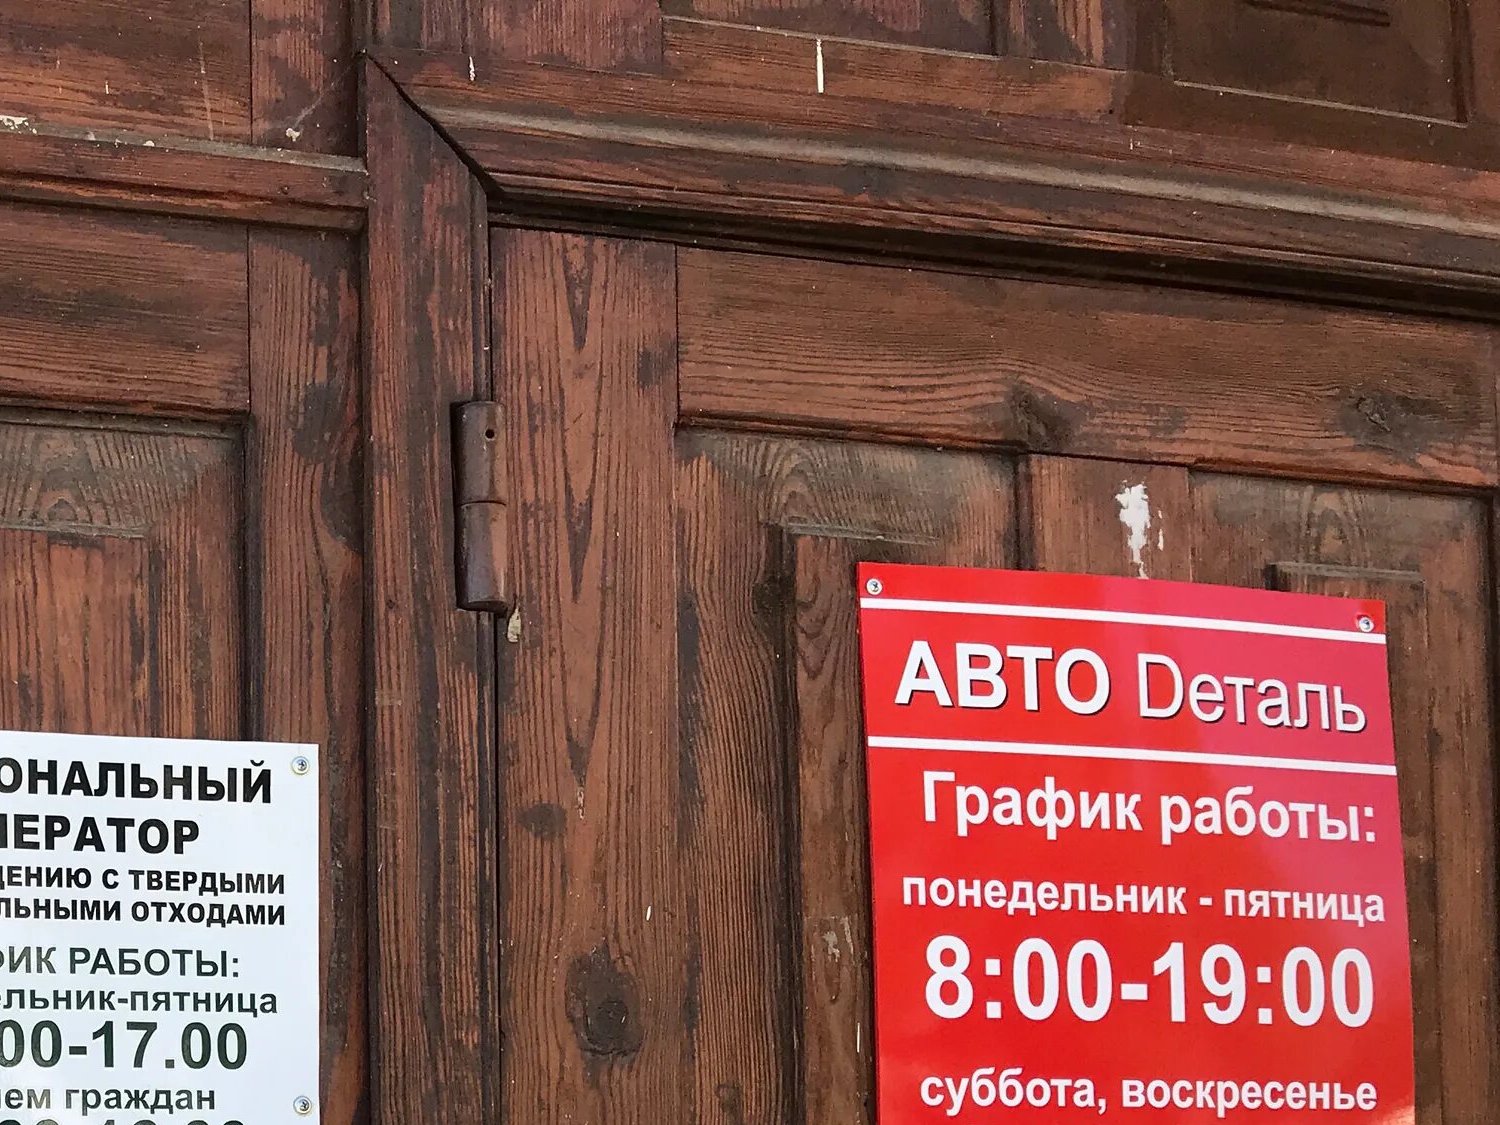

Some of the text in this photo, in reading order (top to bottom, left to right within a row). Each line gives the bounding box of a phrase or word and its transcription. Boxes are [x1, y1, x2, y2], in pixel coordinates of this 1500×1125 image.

[895, 640, 1112, 714] АВТО
[923, 771, 1375, 845] График работы:
[102, 869, 119, 889] С
[128, 869, 284, 897] ТВЕРДЫМИ
[903, 877, 1385, 927] понедельник - пятница
[131, 901, 285, 928] ОТХОДАМИ
[69, 947, 238, 977] РАБОТЫ:
[925, 935, 1373, 1027] 8:00-19:00
[66, 1089, 215, 1116] граждан
[921, 1067, 1377, 1118] суббота, воскресенье
